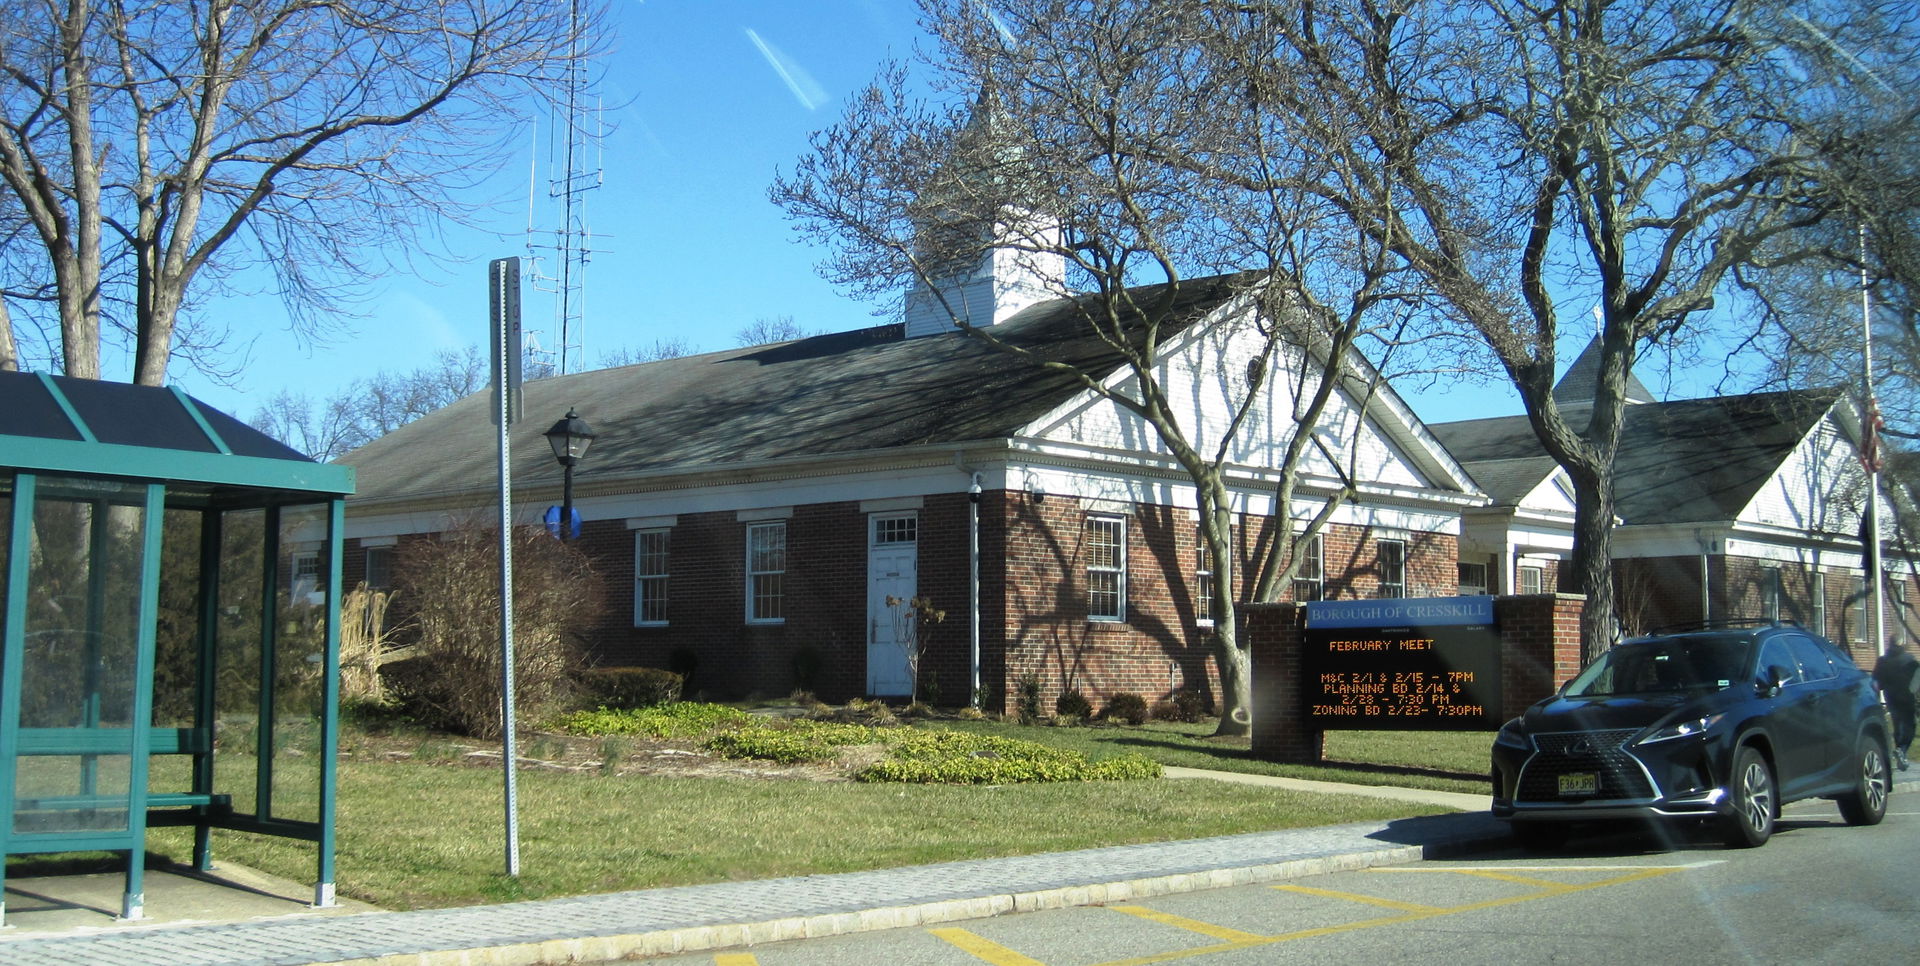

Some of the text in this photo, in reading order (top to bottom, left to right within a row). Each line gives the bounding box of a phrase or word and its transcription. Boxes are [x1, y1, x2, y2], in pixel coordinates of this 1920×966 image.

[1312, 603, 1487, 621] BOROUGH OF CRESSKILL
[1329, 639, 1434, 651] FEBRUARY MEET
[1320, 672, 1345, 683] M&C
[1352, 672, 1373, 683] 2/1
[1379, 672, 1388, 683] &
[1395, 672, 1424, 683] 2/15
[1447, 671, 1474, 682] 7PM
[1324, 682, 1461, 694] PLANNING BD 2/14 &
[1397, 694, 1424, 705] 7:30
[1432, 693, 1450, 705] PM
[1312, 705, 1357, 716] ZONING
[1364, 705, 1380, 716] BD
[1436, 705, 1483, 716] 7:30PM
